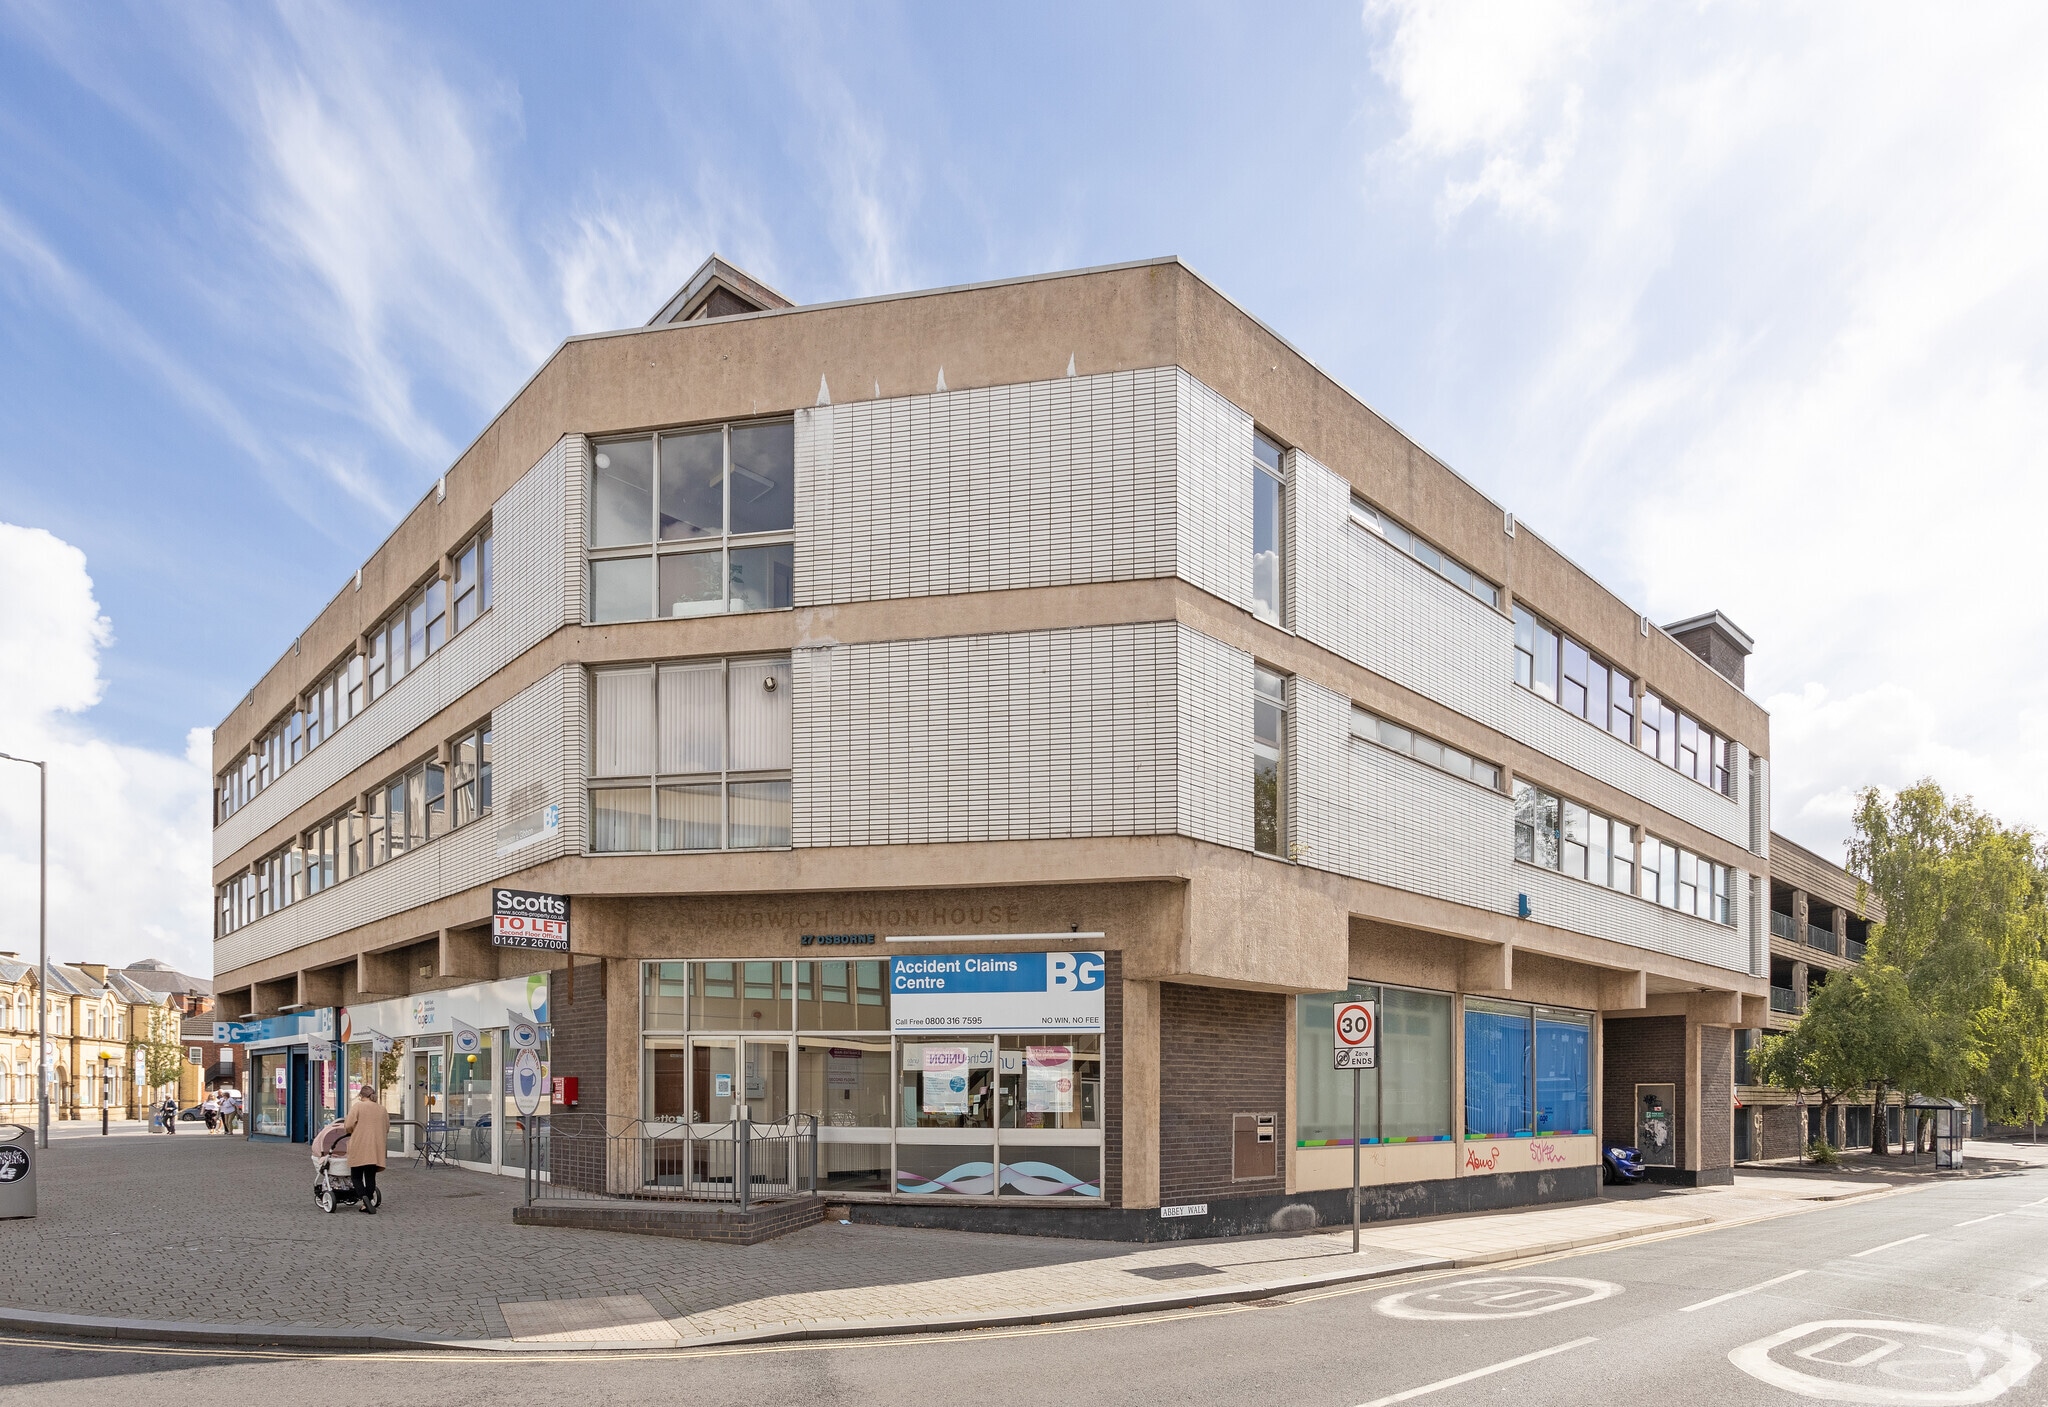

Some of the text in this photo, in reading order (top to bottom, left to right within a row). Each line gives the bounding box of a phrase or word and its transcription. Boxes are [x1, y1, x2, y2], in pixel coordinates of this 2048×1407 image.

[496, 890, 565, 915] Scotts
[496, 909, 564, 920] www.scotts-property.co.uk
[716, 904, 1020, 929] NORWICH UNION HOUSE
[495, 915, 566, 934] TO LET
[493, 935, 568, 950] 01472 267000
[801, 934, 875, 945] 27 OSBORNE
[894, 958, 1018, 974] Accident Claims
[1051, 953, 1105, 992] BG
[895, 976, 945, 989] Centre
[895, 1016, 983, 1026] Call Free 0800 316 7595
[1054, 1017, 1071, 1025] WIN,
[1072, 1016, 1084, 1024] NO
[1085, 1016, 1100, 1024] FEE
[1342, 1017, 1367, 1033] 30
[215, 1022, 246, 1043] BG
[1339, 1054, 1348, 1063] 20
[1351, 1057, 1373, 1065] ENDS
[1162, 1205, 1206, 1217] ABBEY WALK
